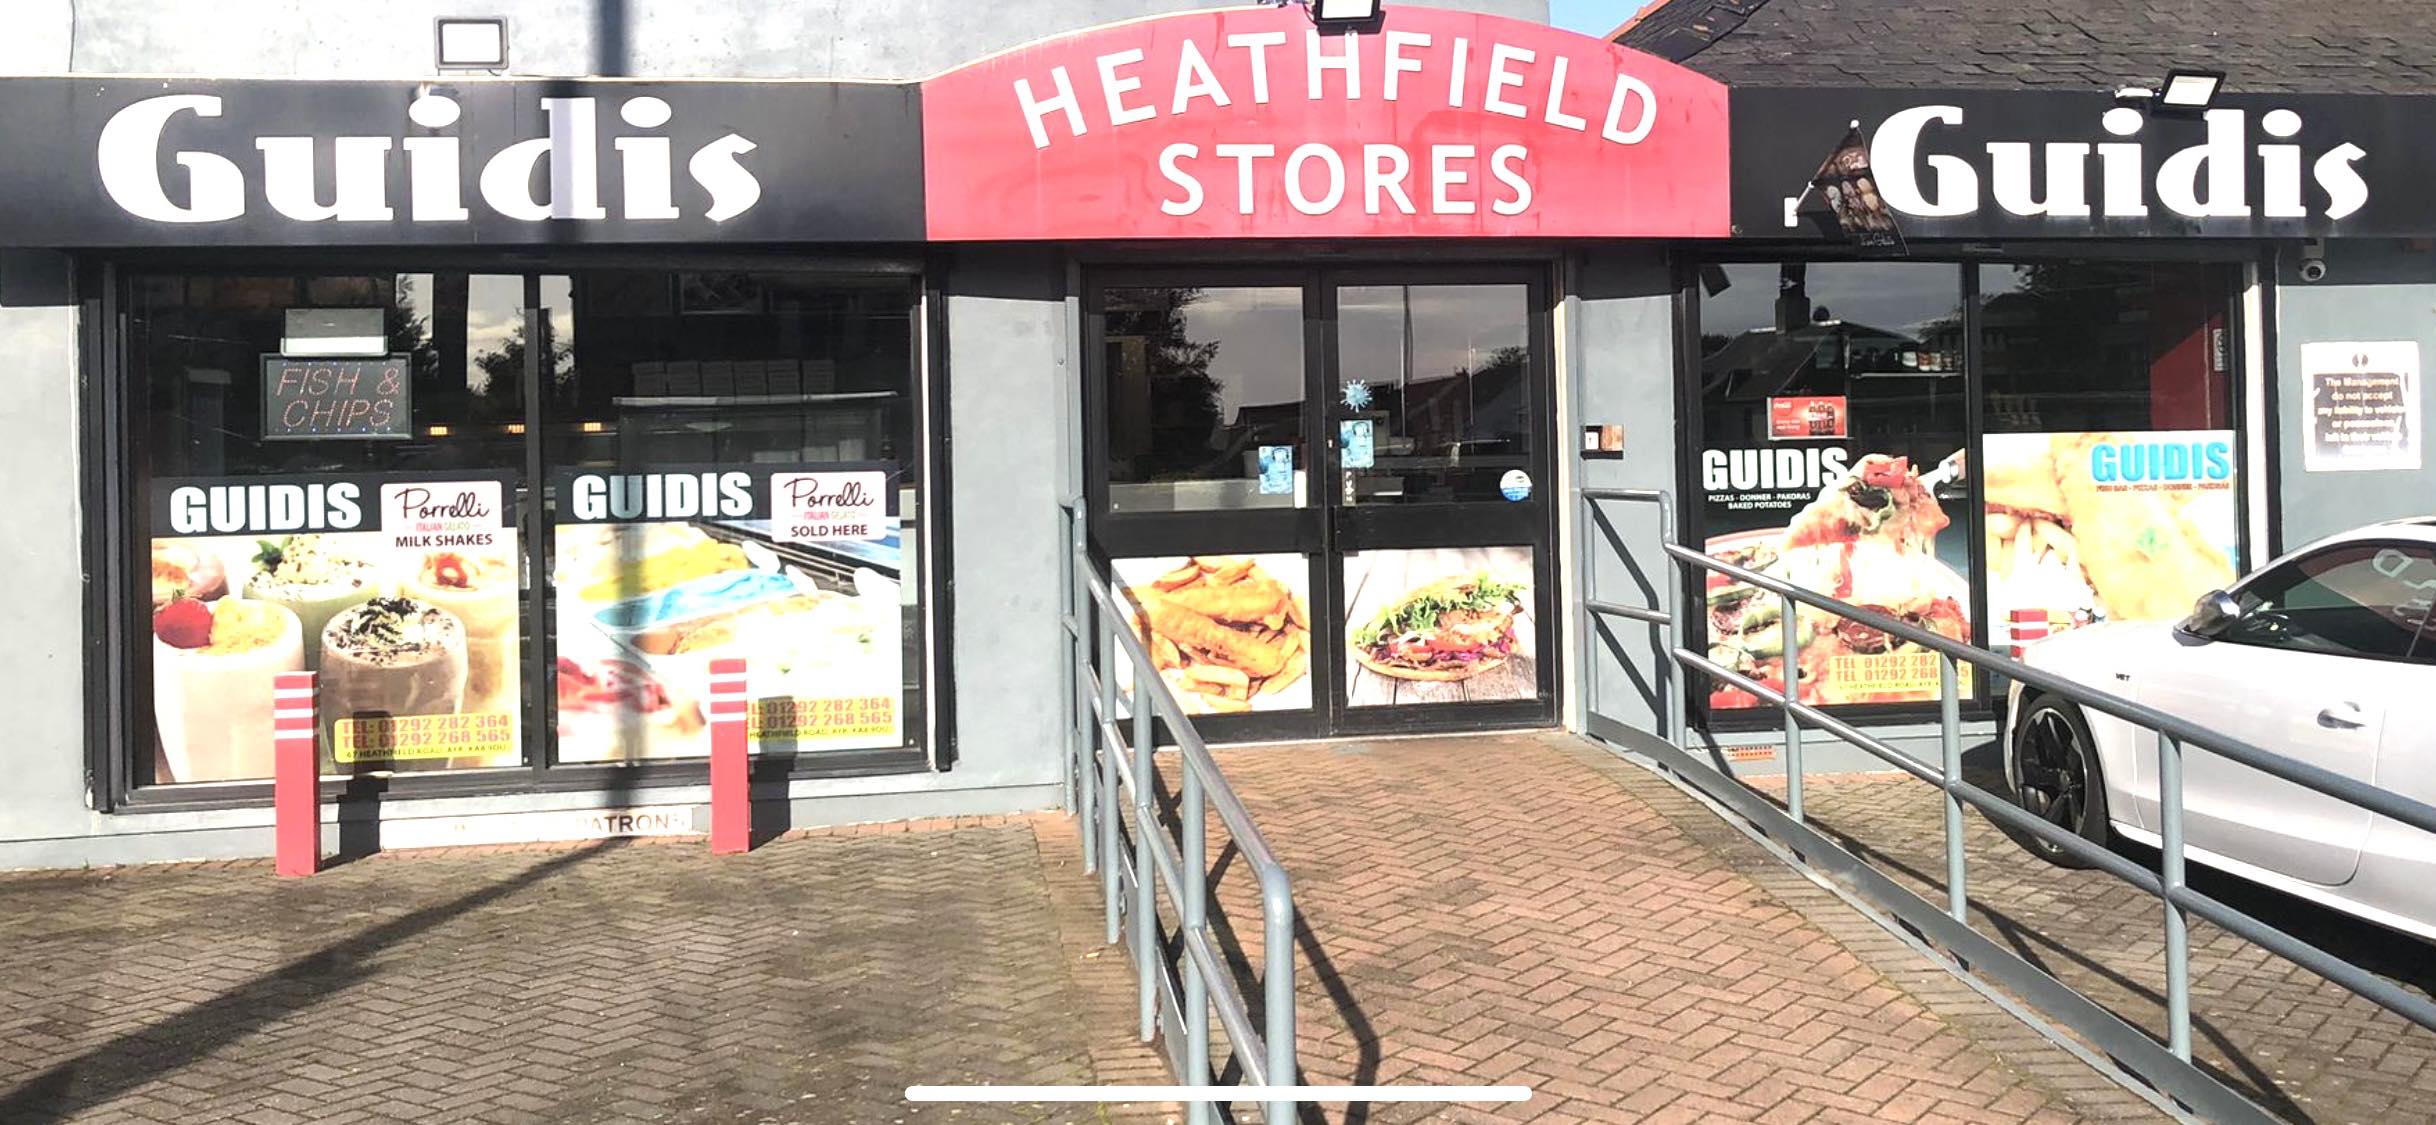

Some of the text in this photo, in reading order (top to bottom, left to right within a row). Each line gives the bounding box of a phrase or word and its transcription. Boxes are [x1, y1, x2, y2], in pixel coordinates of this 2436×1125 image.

[1013, 30, 1658, 149] HEATHFIELD
[97, 94, 762, 223] Guidis
[1870, 105, 2369, 220] Guidis
[1159, 143, 1533, 216] STORES
[276, 367, 400, 396] FISH &
[2331, 391, 2344, 401] do
[2345, 391, 2361, 400] not
[283, 400, 393, 428] CHIPS
[1702, 447, 1848, 490] GUIDIS
[2091, 442, 2230, 482] GUIDIS
[394, 488, 490, 519] Porrelli
[573, 471, 753, 520] GUIDIS
[783, 477, 874, 508] Porrelli
[1708, 494, 1735, 502] PIZZAS
[170, 482, 362, 534] GUIDIS
[1728, 500, 1792, 510] BAKED POTATOES
[395, 534, 493, 548] MILK SHAKES
[791, 524, 868, 537] SOLD HERE
[1835, 654, 1938, 669] TEL 01292 282
[1836, 667, 1938, 682] TEL 01292 268
[767, 700, 818, 715] 01292
[823, 698, 854, 713] 282
[859, 697, 891, 711] 364
[343, 714, 509, 735] TEL: 01292 282 364
[767, 714, 818, 729] 01292
[823, 713, 856, 726] 268
[859, 711, 893, 725] 565
[343, 729, 512, 749] TEL: 01292 268 565
[577, 814, 685, 833] ATRON
